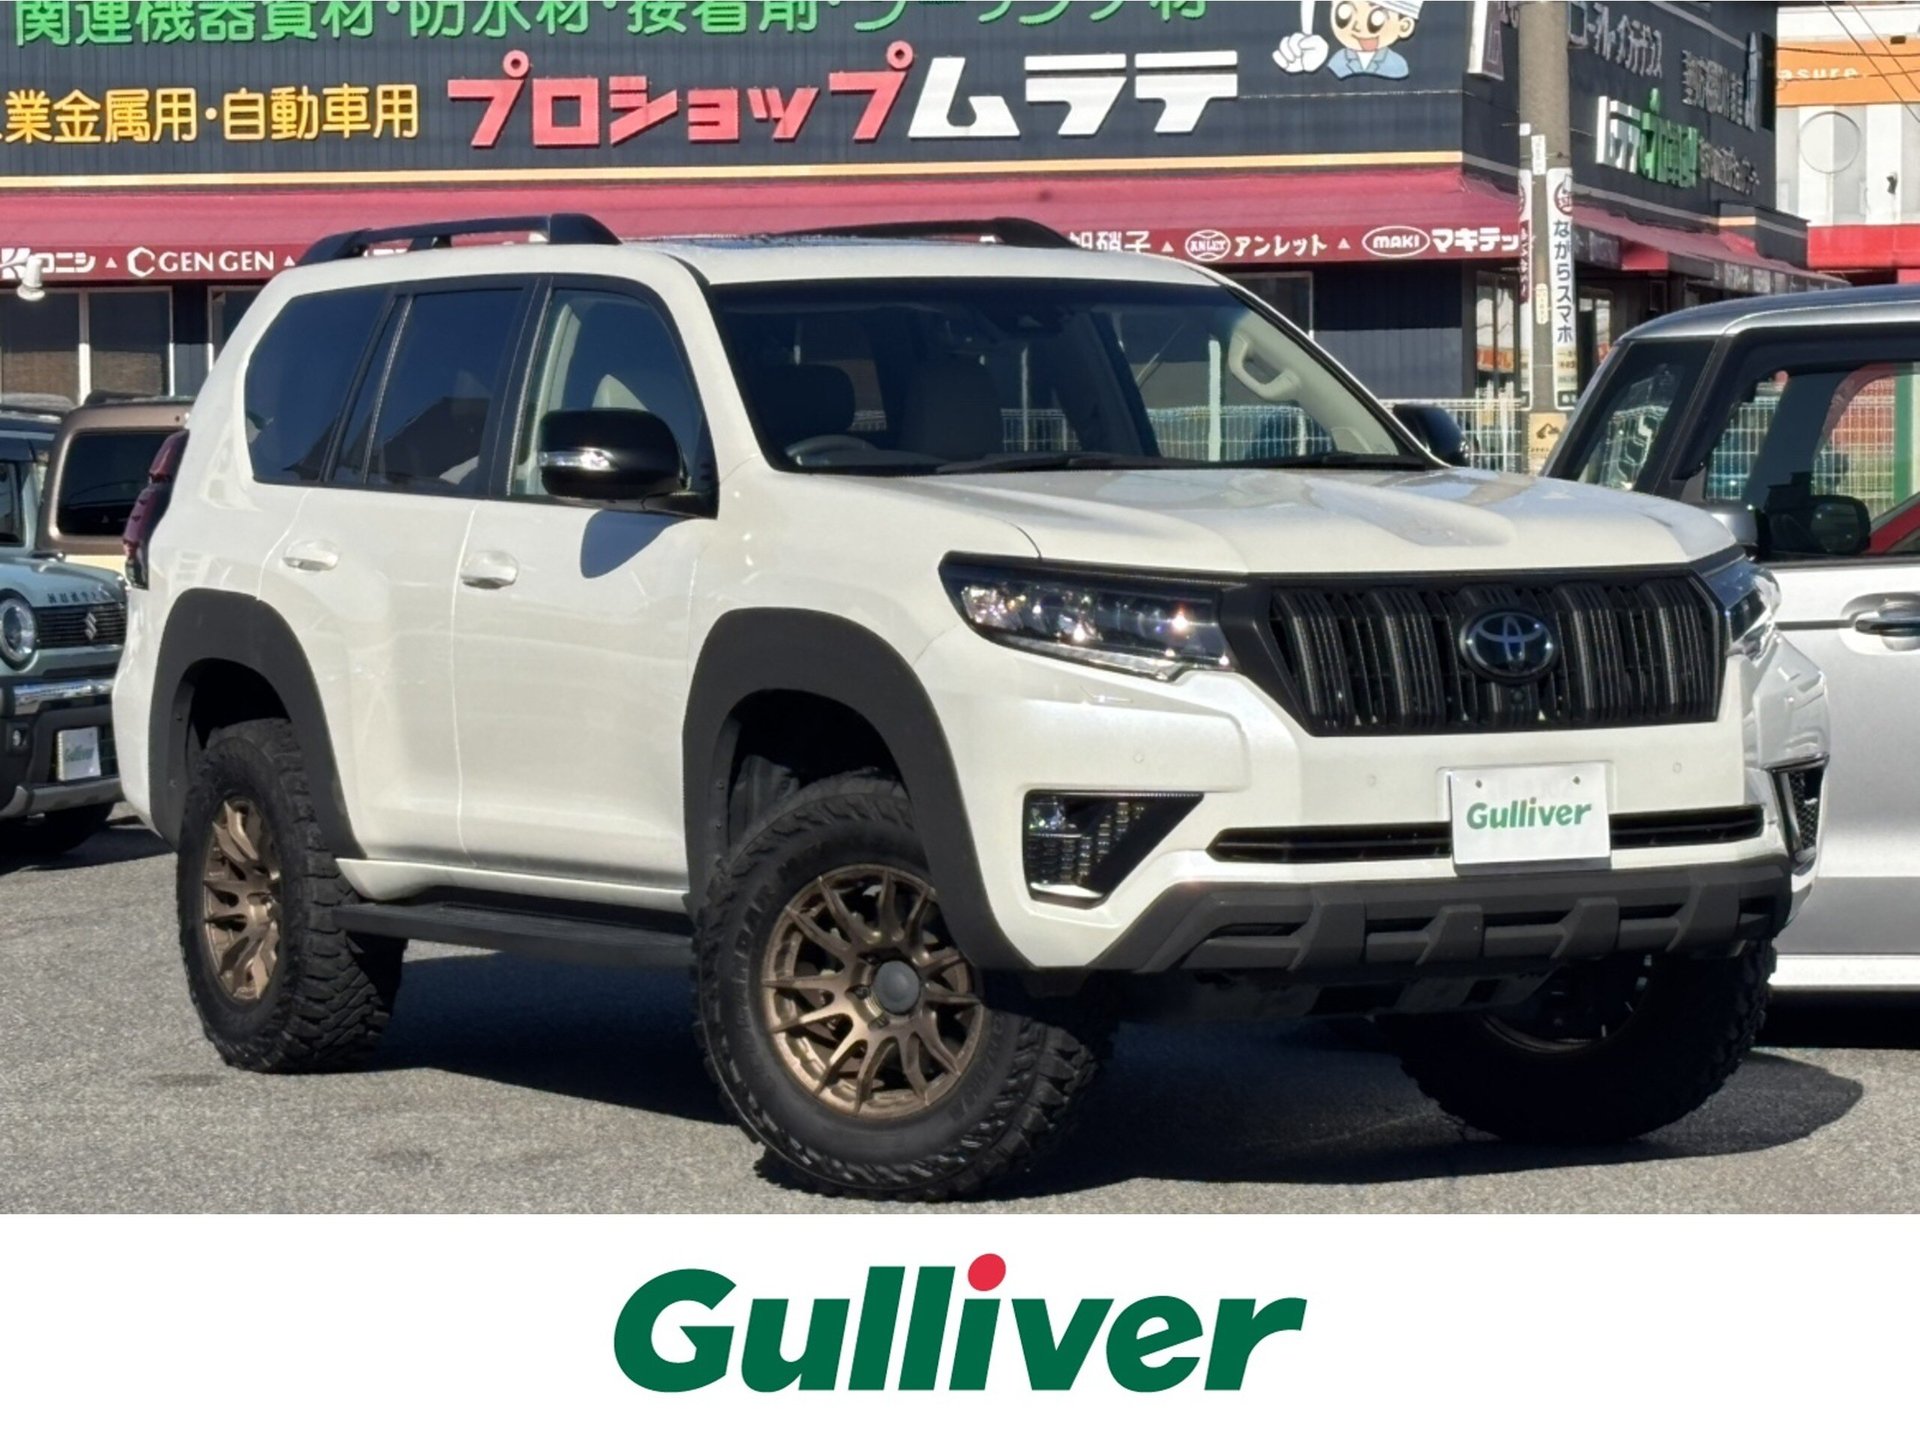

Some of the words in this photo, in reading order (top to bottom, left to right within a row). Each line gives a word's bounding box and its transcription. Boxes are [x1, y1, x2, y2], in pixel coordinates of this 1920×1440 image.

[0, 84, 419, 143] 業金属用・自動車用
[1234, 233, 1328, 257] アンレット
[1373, 235, 1420, 249] MAKI
[1553, 219, 1574, 343] ながらスマホ
[1466, 796, 1593, 830] Gulliver
